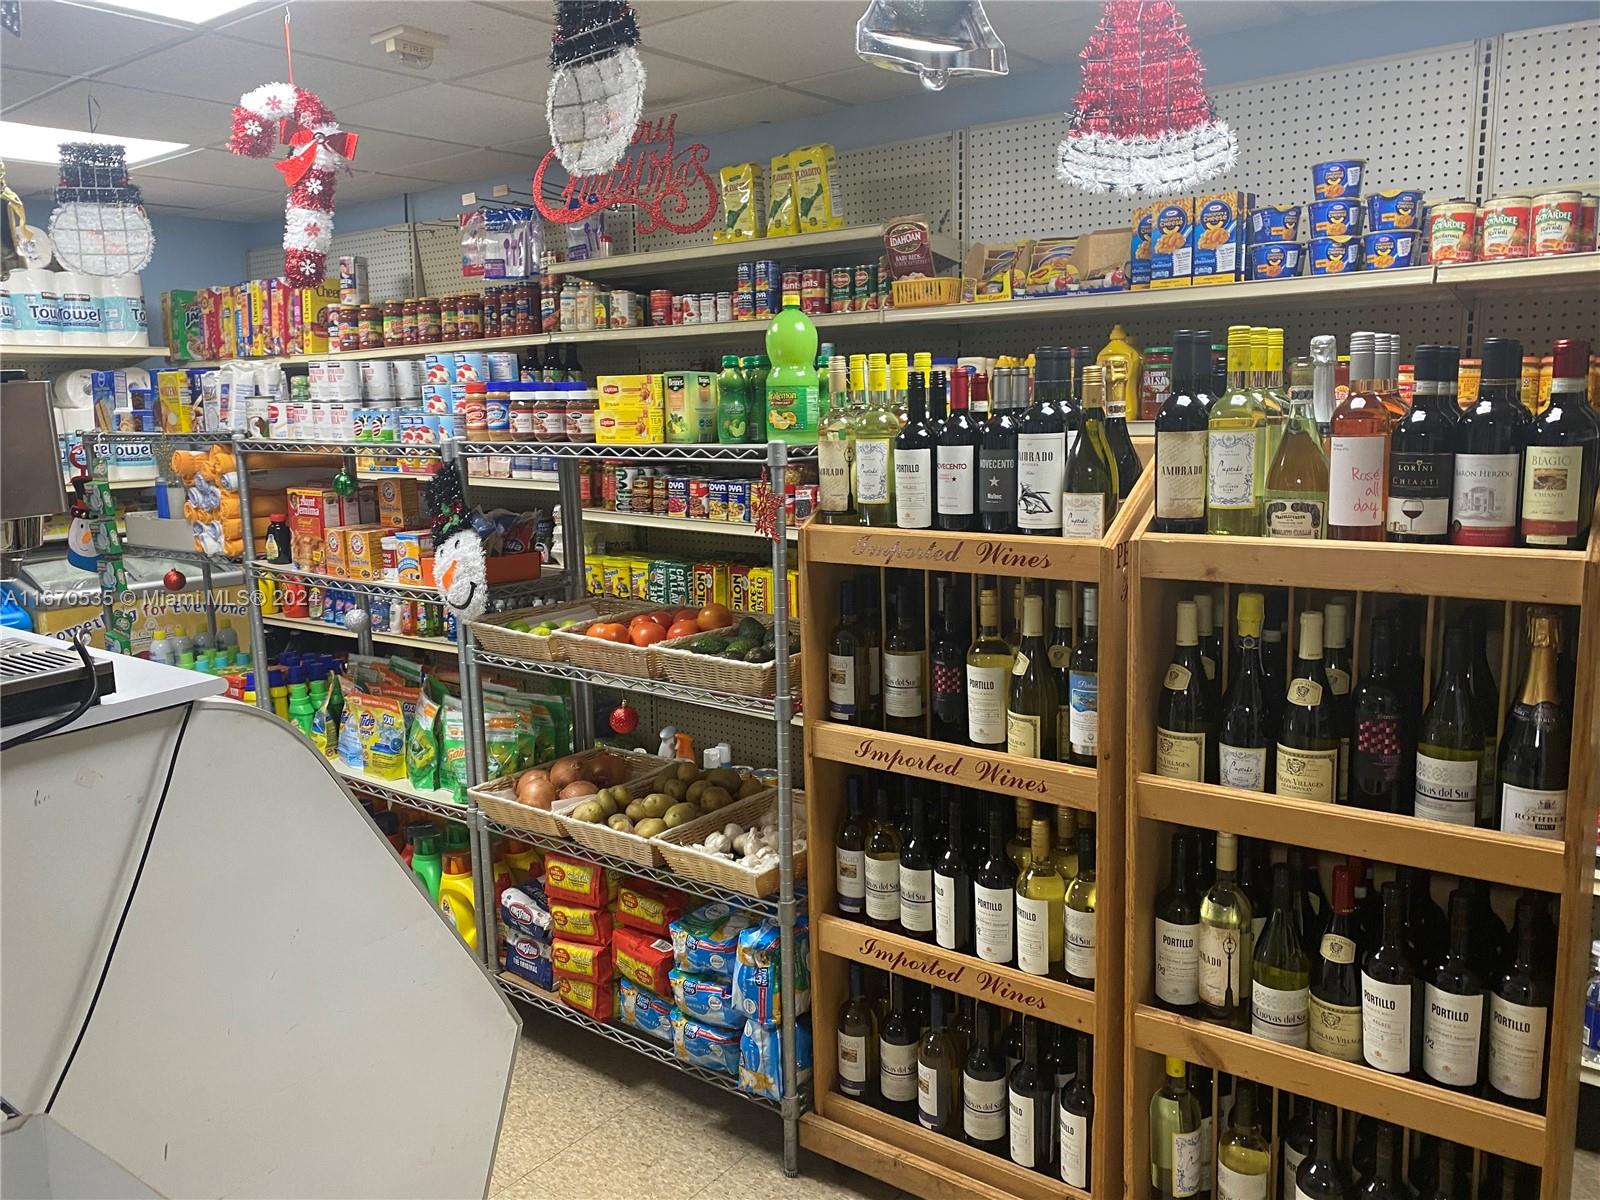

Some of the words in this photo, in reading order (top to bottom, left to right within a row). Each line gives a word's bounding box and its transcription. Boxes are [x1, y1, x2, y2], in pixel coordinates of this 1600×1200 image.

[403, 43, 425, 56] FIRE
[890, 231, 921, 247] IDAHOAN
[1532, 455, 1571, 466] BIAGIO
[896, 463, 920, 473] PORTILLO
[1479, 469, 1513, 478] HERZOG
[1392, 476, 1440, 486] CHIANTI
[1365, 482, 1379, 497] all
[1353, 499, 1378, 520] day
[976, 539, 1053, 569] Wines
[676, 568, 685, 592] CAFE
[143, 604, 167, 616] for
[969, 678, 995, 690] PORTILLO
[361, 714, 375, 727] Tide
[854, 740, 963, 778] Imported
[974, 760, 1050, 794] Wines
[1438, 786, 1453, 799] del
[977, 897, 1002, 911] PORTILLO
[1163, 934, 1194, 948] PORTILLO
[858, 938, 965, 984] Imported
[976, 971, 1047, 1010] Wines
[1364, 989, 1395, 1010] PORTILLO
[1283, 1011, 1295, 1024] del
[1431, 1003, 1469, 1022] PORTILLO
[1494, 1011, 1530, 1033] PORTILLO
